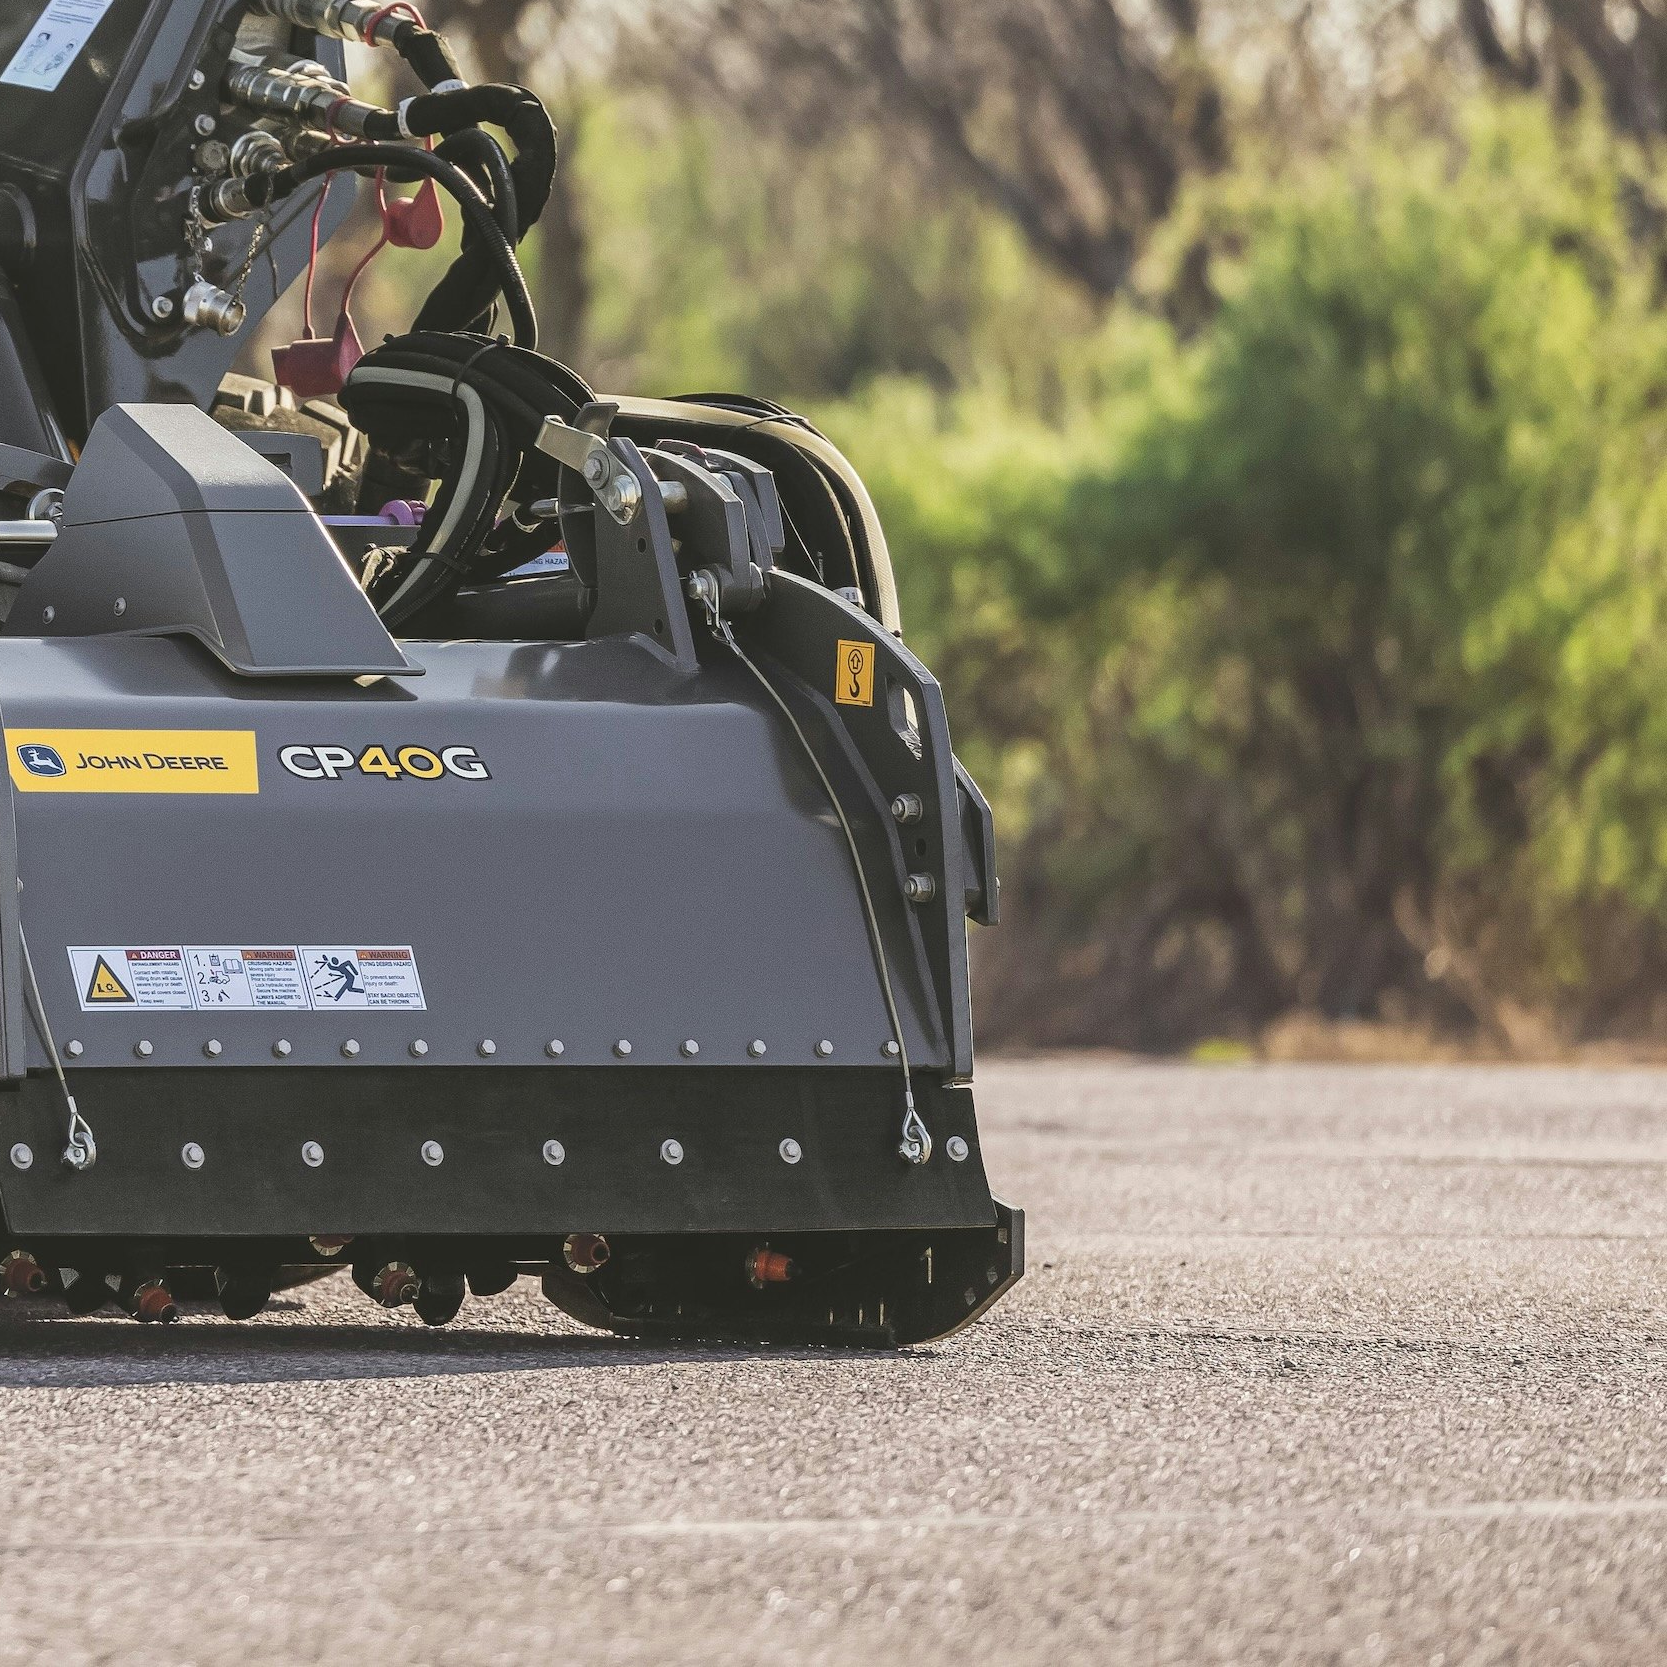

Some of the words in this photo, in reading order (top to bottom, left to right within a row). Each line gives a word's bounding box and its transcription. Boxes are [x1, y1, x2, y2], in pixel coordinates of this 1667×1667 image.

[75, 752, 142, 771] JOHN
[146, 752, 229, 771] DEERE
[279, 745, 489, 780] CP40G
[140, 951, 177, 959] DANGER
[193, 954, 206, 967] 1.
[254, 951, 293, 959] WARNING
[369, 951, 408, 959] WARNING
[197, 972, 210, 984] 2.
[202, 989, 214, 1002] 3.
